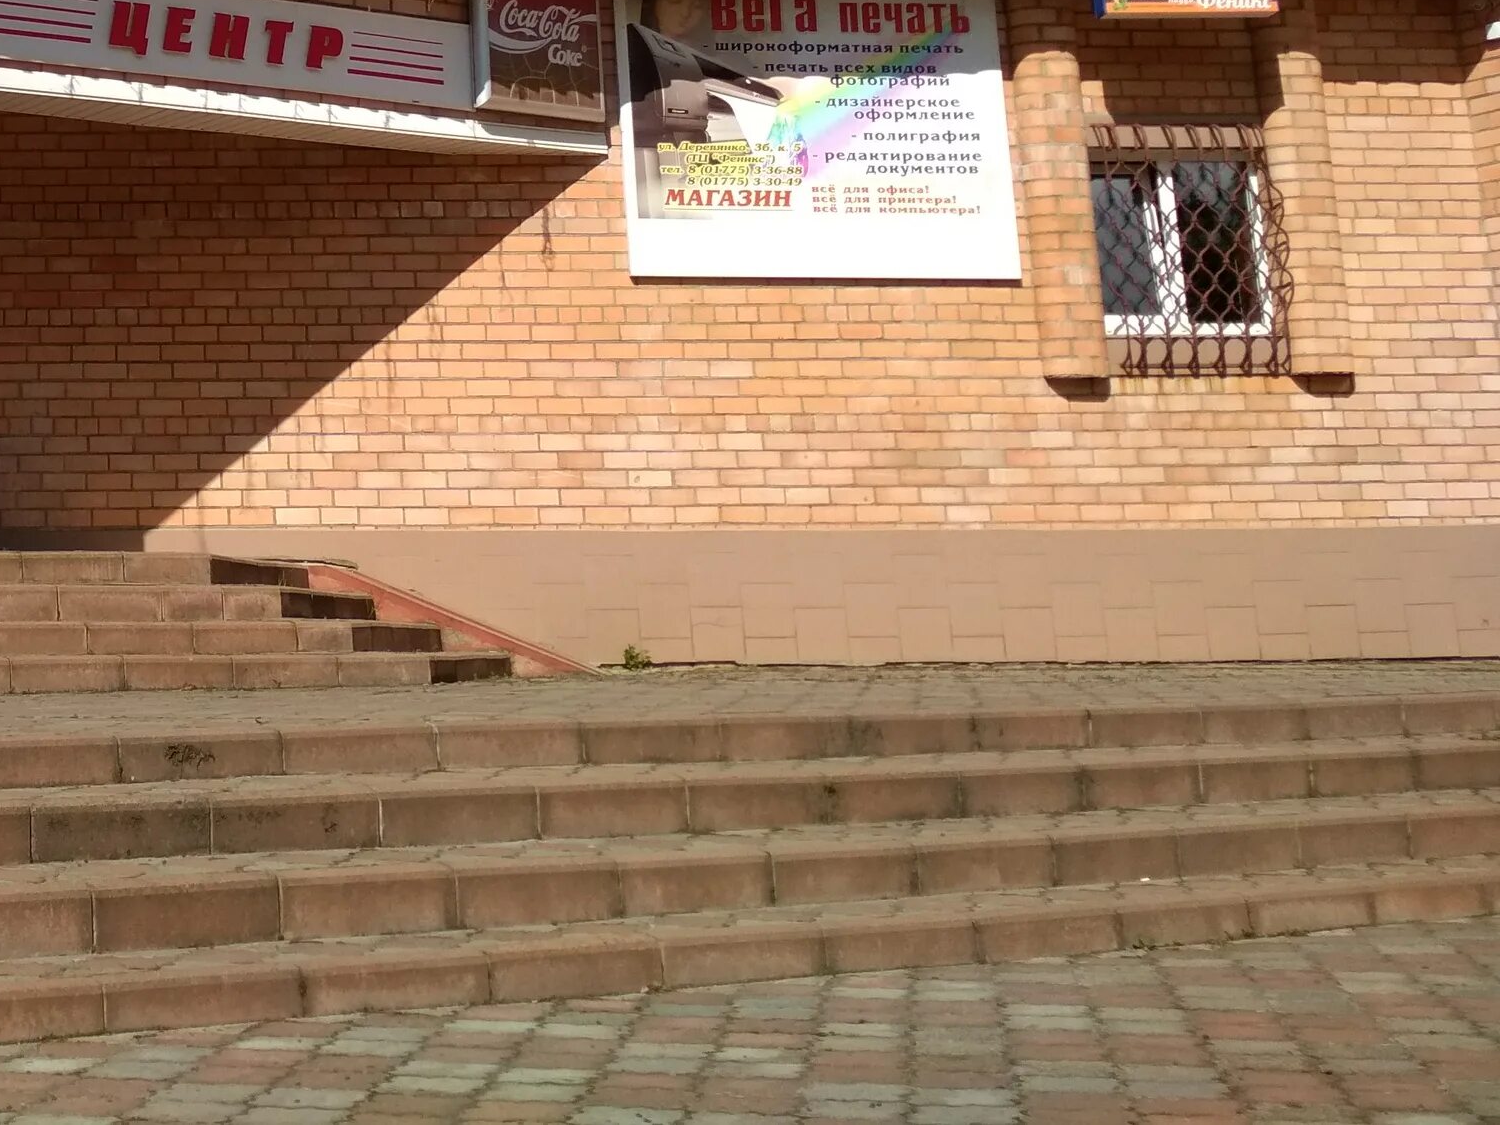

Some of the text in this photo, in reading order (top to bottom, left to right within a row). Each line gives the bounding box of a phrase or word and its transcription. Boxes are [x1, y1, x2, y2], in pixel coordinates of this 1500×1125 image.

[500, 0, 581, 43] Coca-Cola
[839, 2, 971, 34] печать
[107, 0, 345, 70] ЦЕНТР
[715, 40, 893, 55] широкоформатная
[900, 43, 964, 54] печать
[548, 44, 583, 66] Coke
[764, 62, 828, 73] печать
[834, 64, 875, 73] всех
[881, 65, 937, 74] видов
[830, 74, 950, 89] фотографий
[826, 96, 961, 108] дизайнерское
[854, 108, 975, 122] оформление
[863, 130, 981, 144] полиграфия
[825, 151, 983, 164] редактирование
[866, 164, 979, 176] документов
[687, 177, 695, 185] 8
[700, 177, 749, 186] (01775)
[843, 186, 869, 194] для
[877, 185, 930, 195] офиса!
[665, 188, 792, 207] МАГАЗИН
[844, 196, 870, 204] для
[878, 195, 957, 205] принтера!
[845, 206, 871, 214] для
[879, 205, 981, 216] компьютера!
